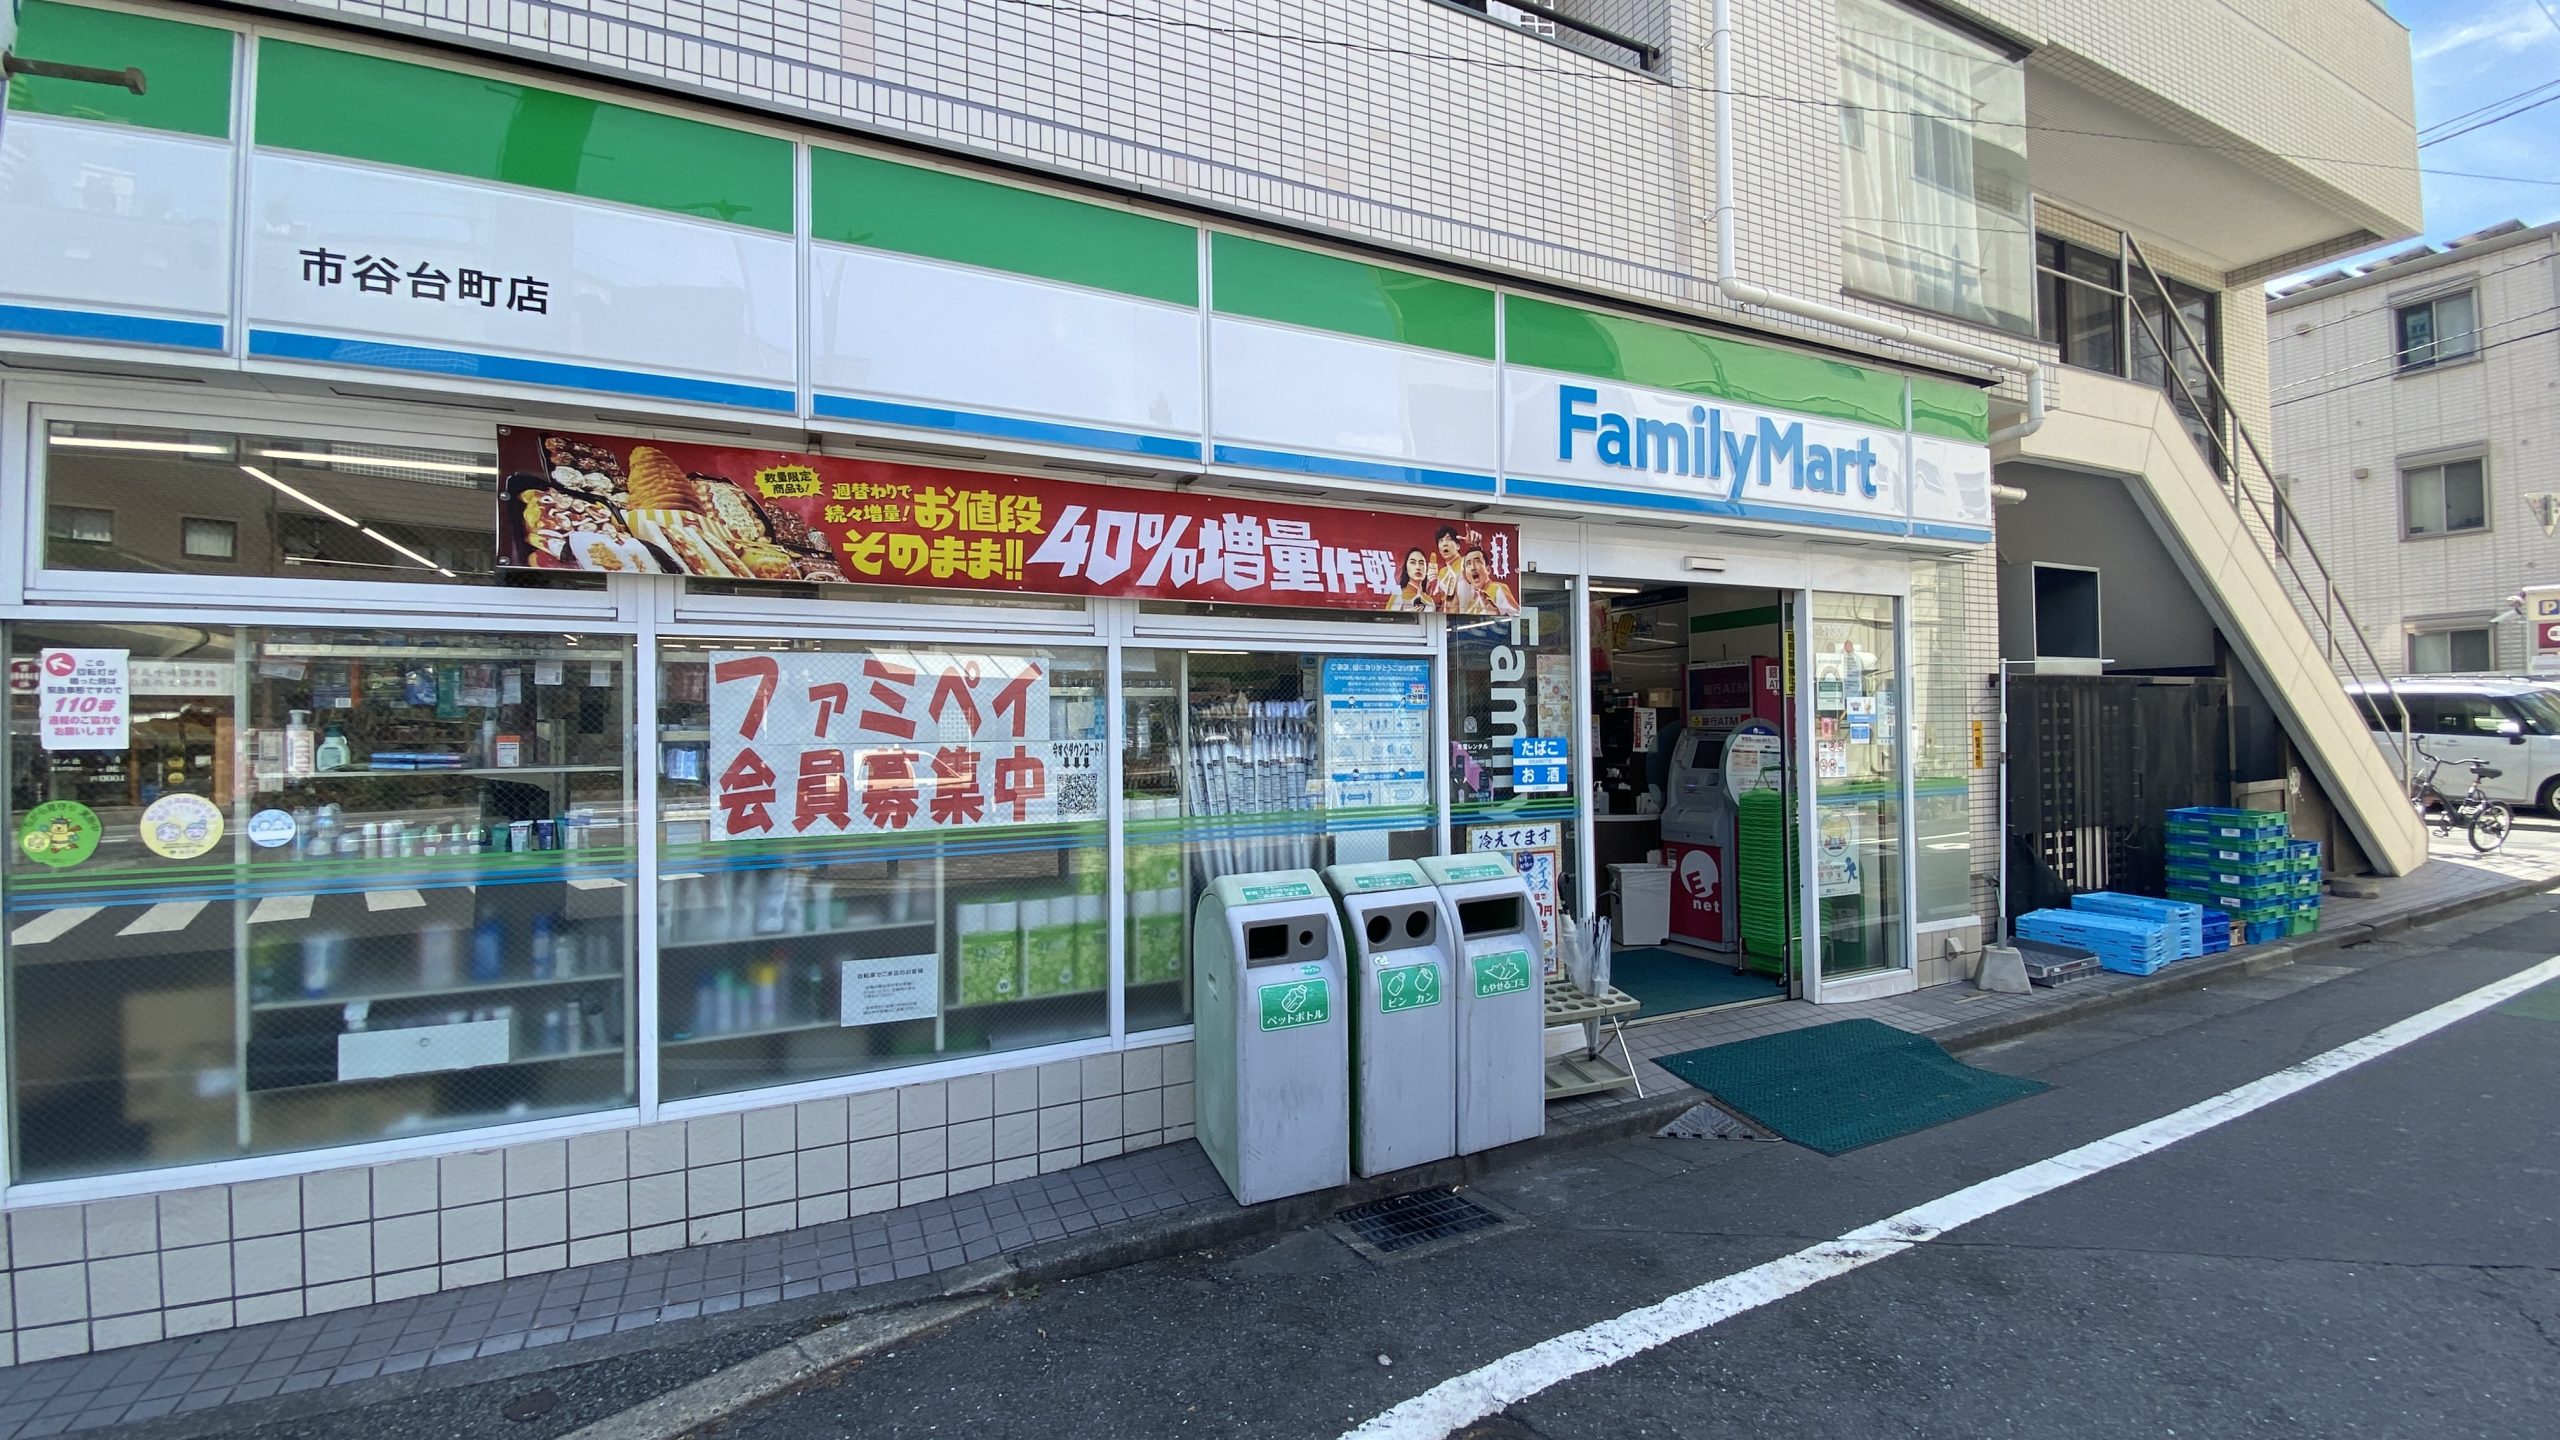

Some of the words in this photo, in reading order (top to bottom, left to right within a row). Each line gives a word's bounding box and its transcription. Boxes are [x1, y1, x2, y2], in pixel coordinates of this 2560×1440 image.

[299, 247, 549, 315] 市谷台町店
[1557, 384, 1878, 501] FamilyMart
[764, 470, 813, 484] 数量限定
[832, 482, 913, 501] 週替わりで
[824, 503, 910, 525] 続々増量!
[914, 486, 1046, 535] お値段
[1026, 504, 1402, 595] 40%増量作戦
[85, 659, 105, 667] この
[76, 668, 117, 676] 回転灯が
[55, 697, 116, 713] 110番
[715, 655, 1043, 741] ファミペイ
[48, 715, 121, 725] 通報のご協力を
[54, 726, 117, 736] お願いします
[1521, 740, 1559, 757] たばこ
[719, 744, 1046, 835] 会員募集中
[1478, 828, 1551, 850] 冷えてます
[1536, 856, 1551, 891] アイス
[1692, 899, 1720, 913] net
[1481, 978, 1525, 993] もやせるゴミ
[1388, 997, 1407, 1008] ビン
[1415, 992, 1434, 1005] カン
[1266, 1009, 1325, 1025] ペットボトル
